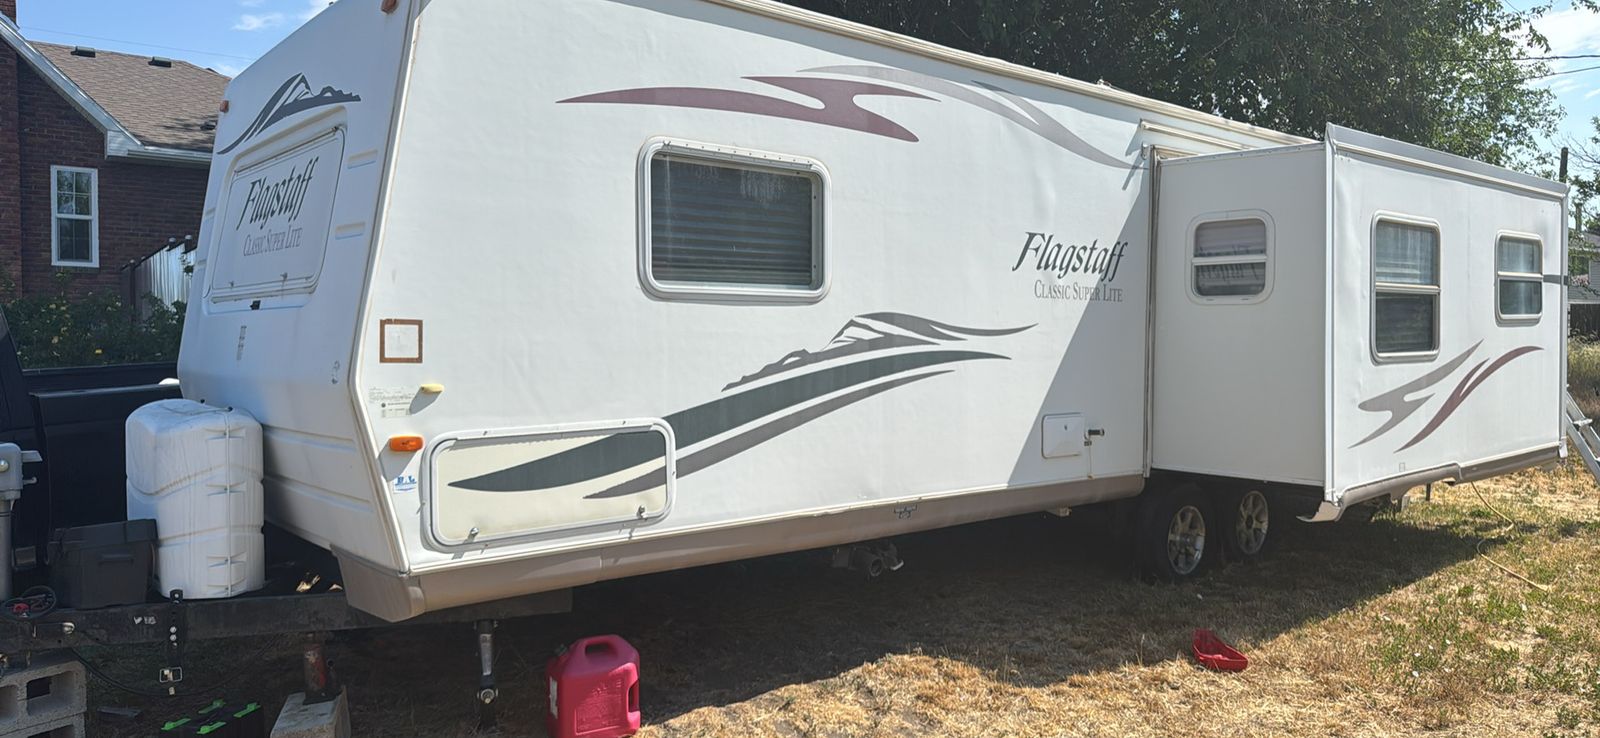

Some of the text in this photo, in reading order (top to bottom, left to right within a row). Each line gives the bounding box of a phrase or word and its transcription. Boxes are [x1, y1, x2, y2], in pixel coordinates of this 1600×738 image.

[236, 156, 319, 230] Flagstaff
[1012, 232, 1128, 282] Flagstaff
[1034, 280, 1123, 303] CLASSIC SUPER LITE
